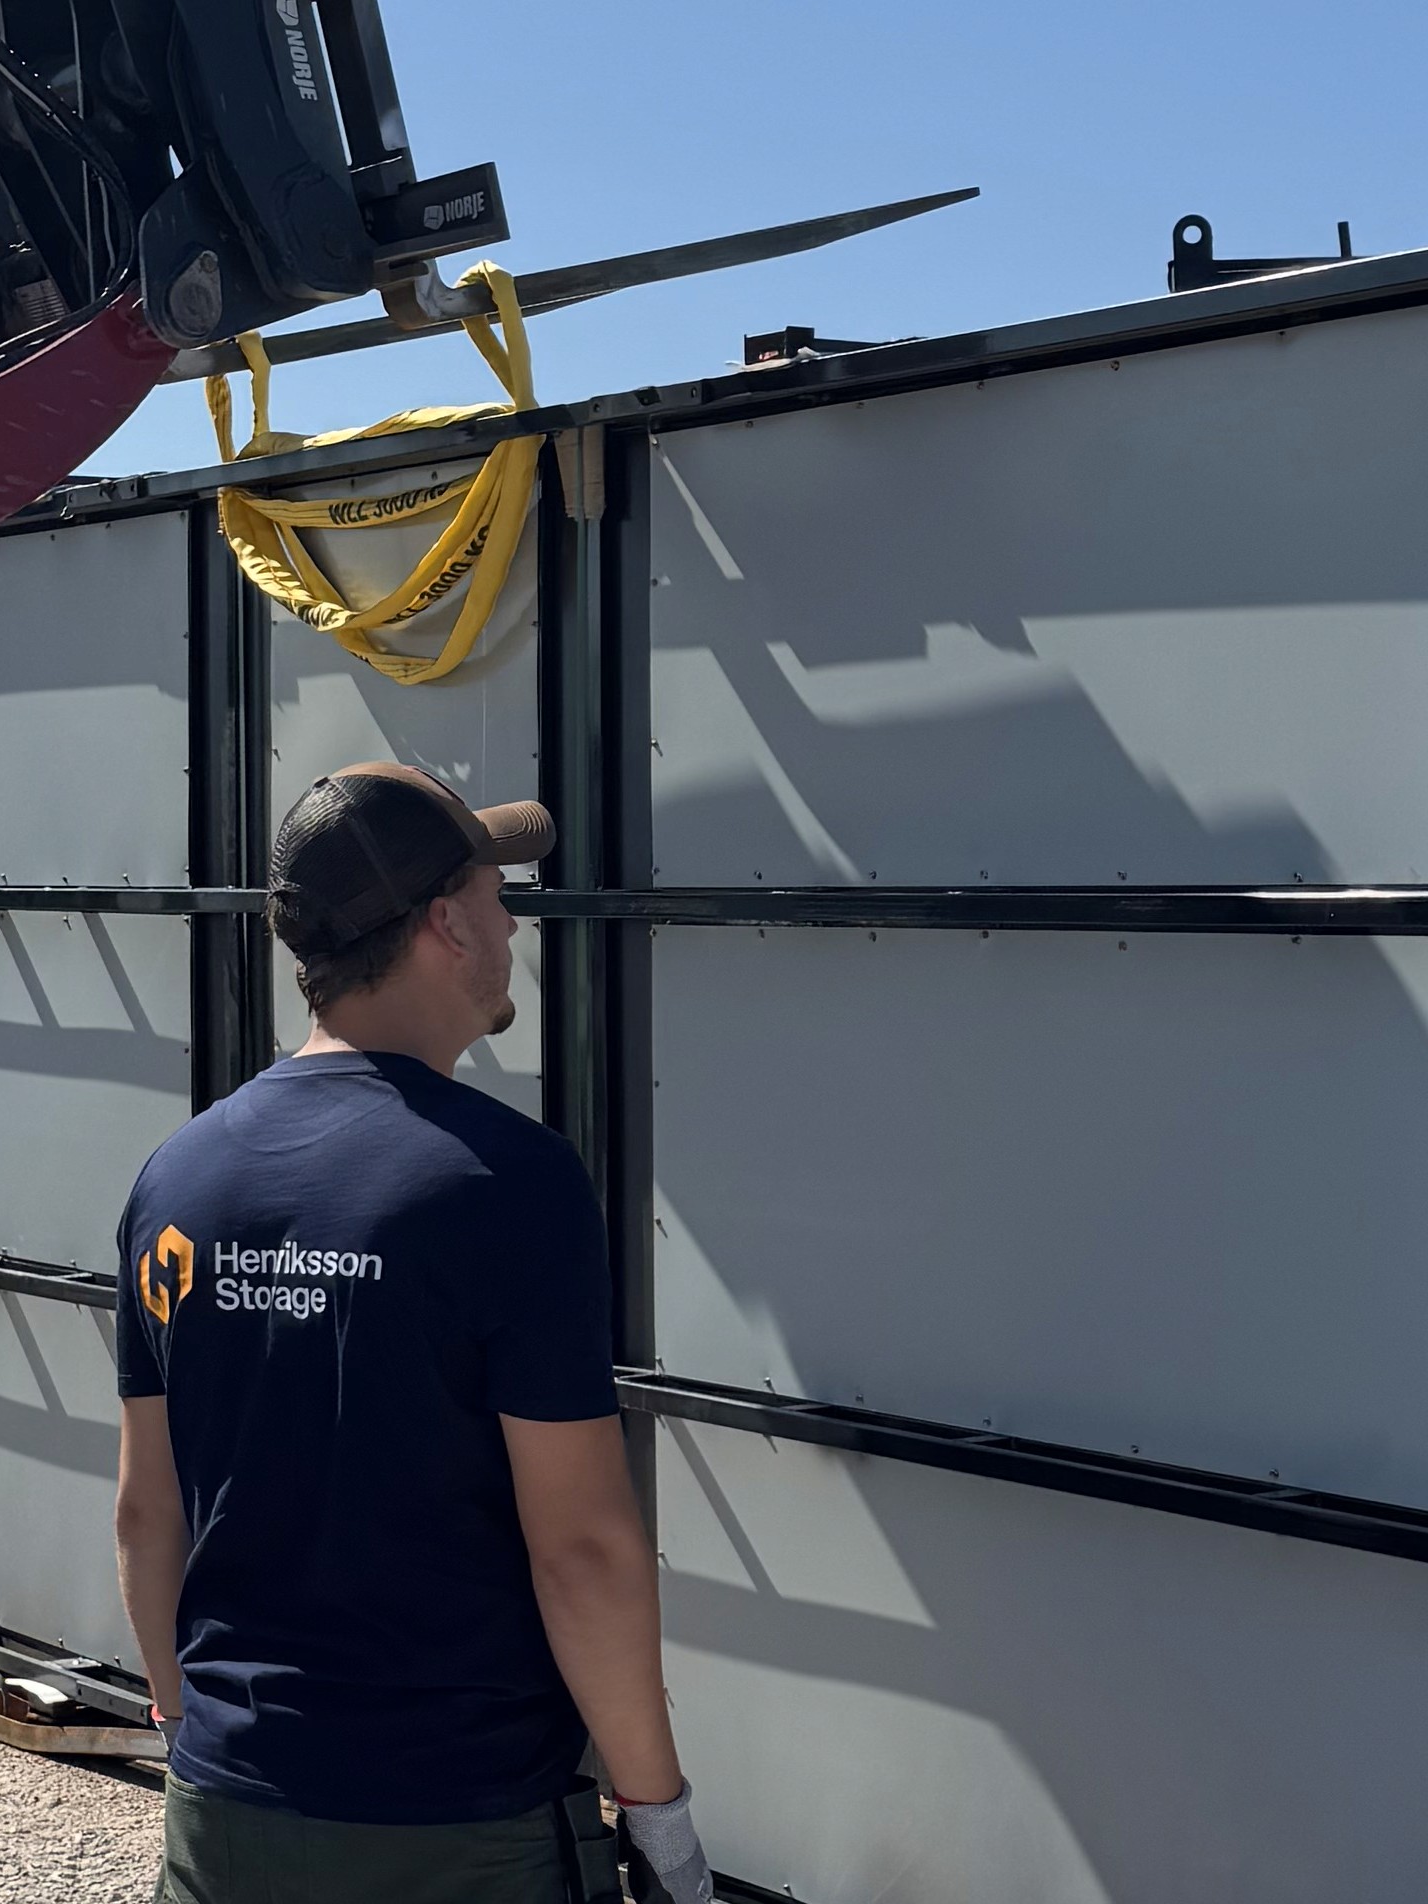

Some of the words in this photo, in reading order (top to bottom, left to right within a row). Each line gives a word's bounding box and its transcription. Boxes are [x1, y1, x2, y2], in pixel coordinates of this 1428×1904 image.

[285, 29, 318, 101] NORJE
[445, 191, 485, 222] NORJE
[215, 1241, 383, 1280] Henriksson
